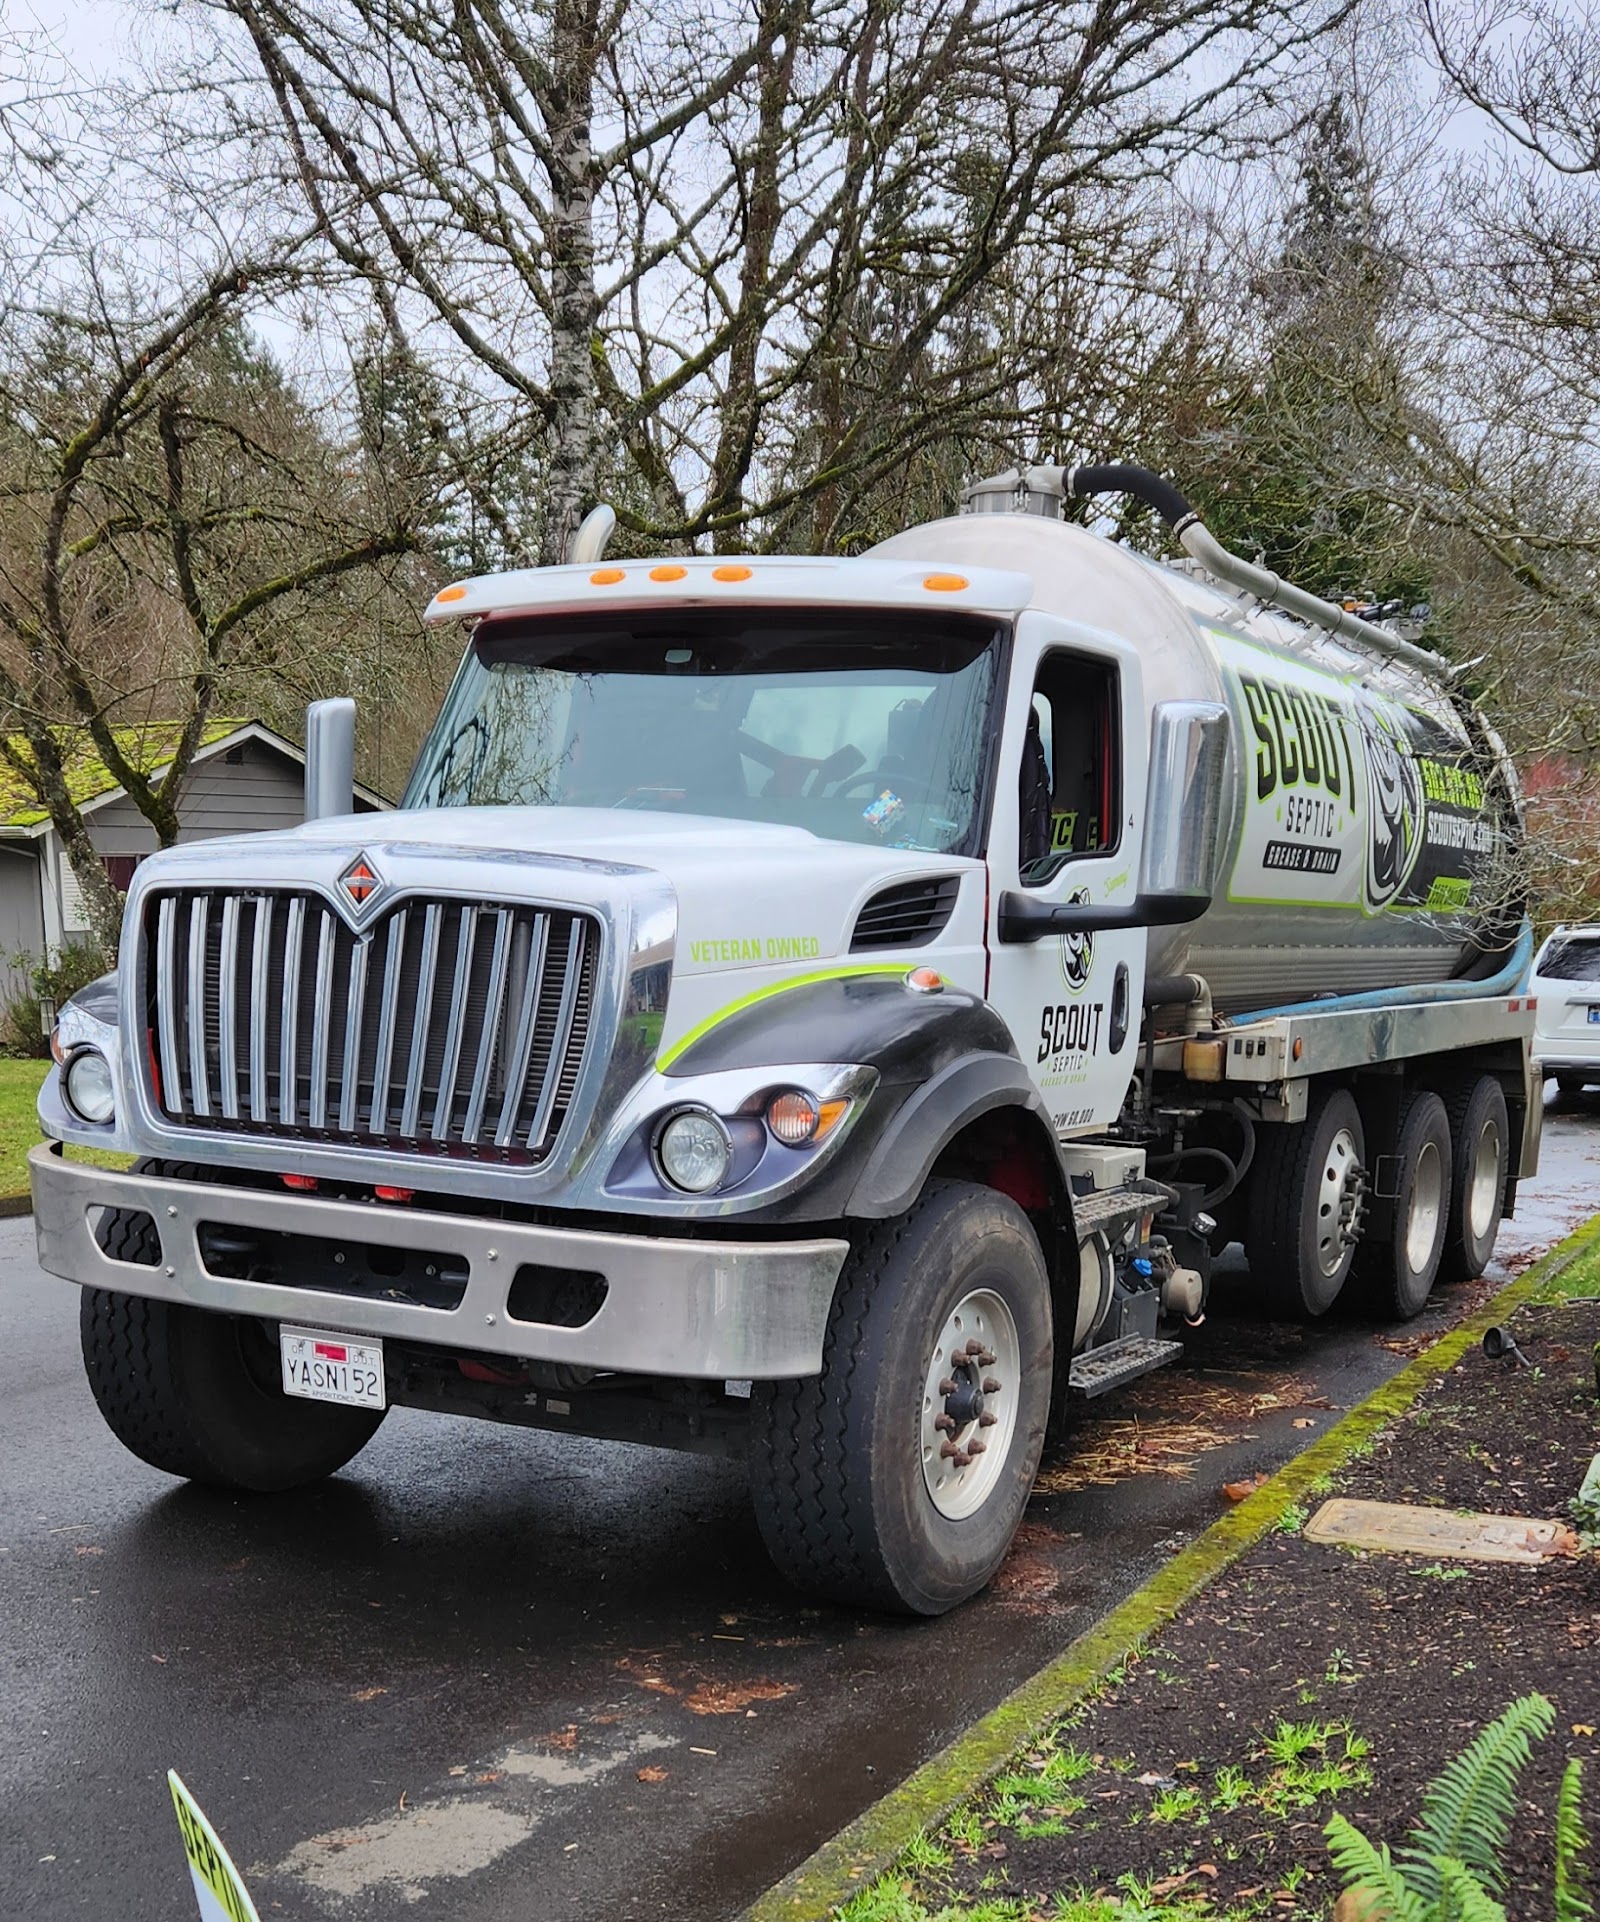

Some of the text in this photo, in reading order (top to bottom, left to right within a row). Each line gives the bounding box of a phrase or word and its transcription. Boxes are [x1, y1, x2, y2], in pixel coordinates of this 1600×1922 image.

[1239, 673, 1355, 815] SCOUT
[1286, 795, 1335, 838] SEPTIC
[1266, 845, 1303, 868] GREASE
[1311, 851, 1338, 871] DRAIN
[691, 937, 818, 962] VETERAN OWNED
[1037, 1003, 1104, 1064] SCOUT
[1052, 1054, 1083, 1073] SEPTIC
[287, 1358, 378, 1397] YASN152
